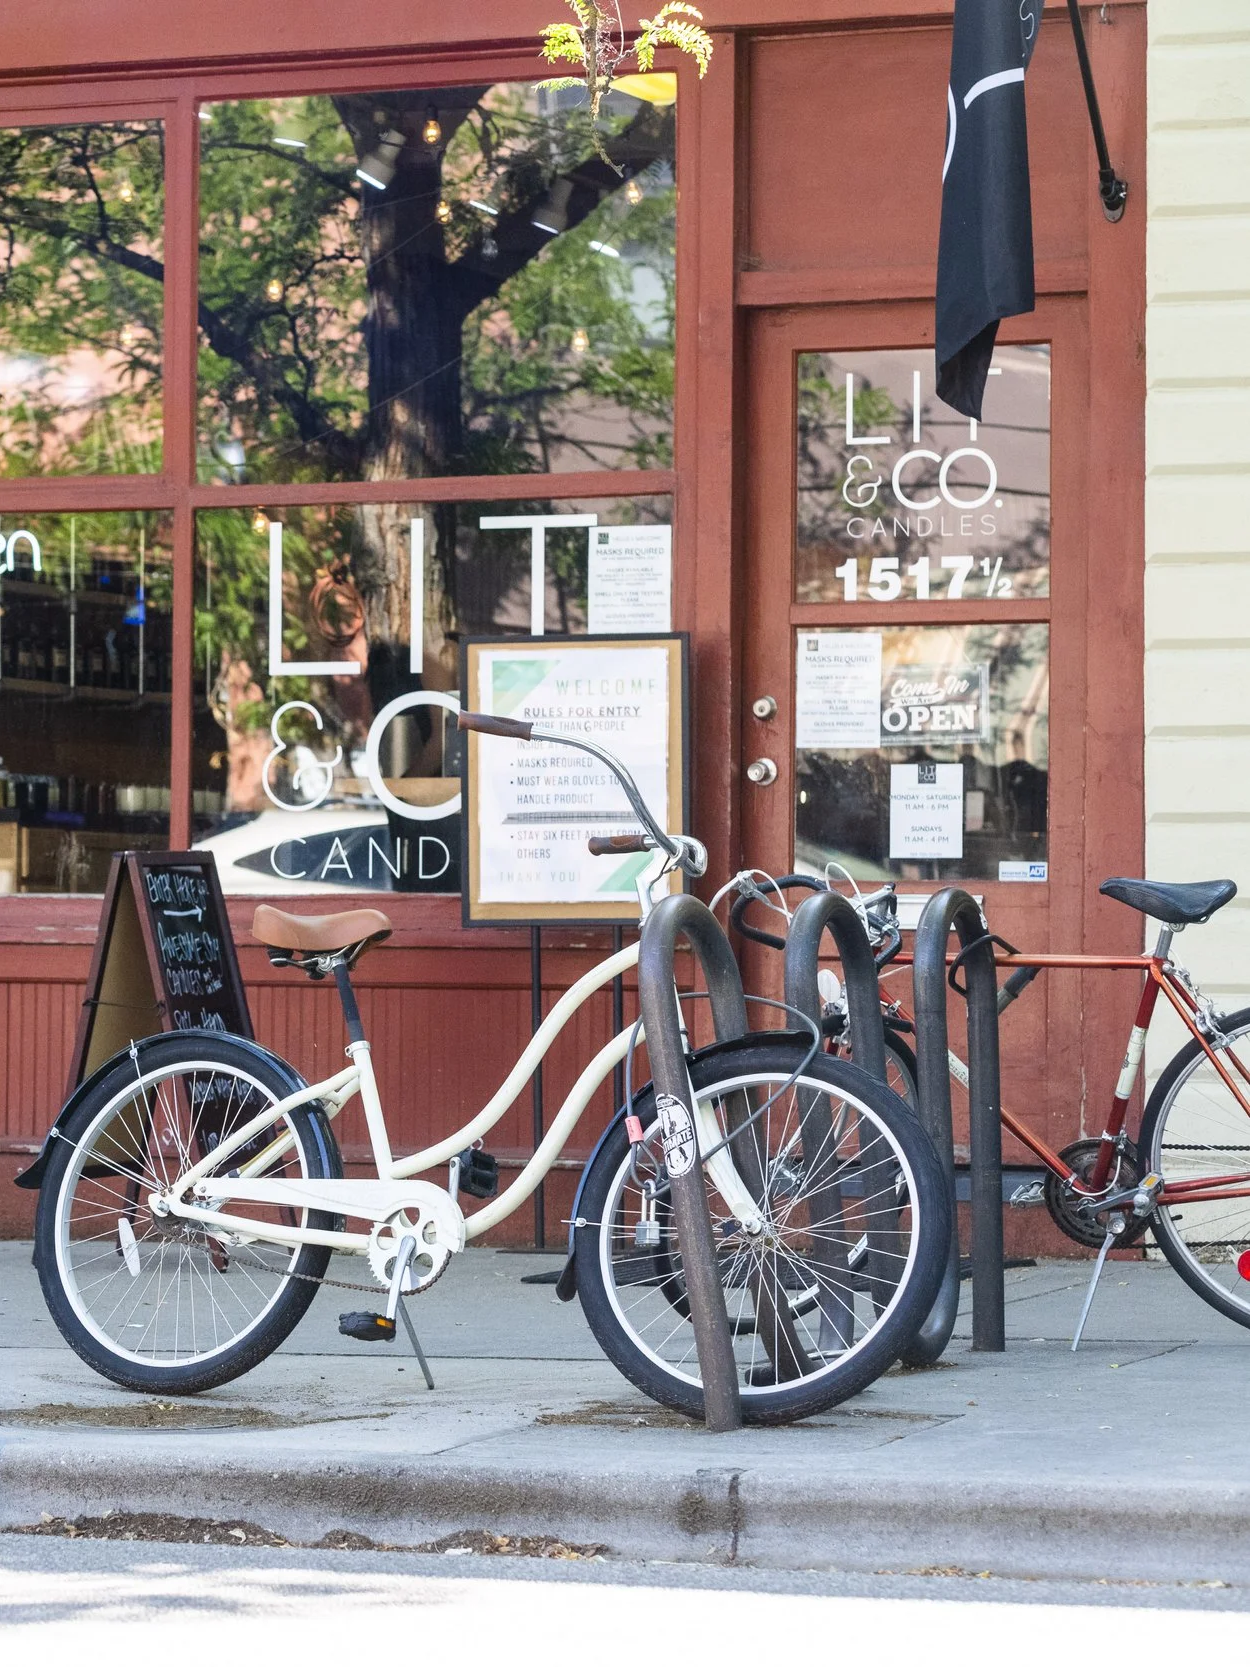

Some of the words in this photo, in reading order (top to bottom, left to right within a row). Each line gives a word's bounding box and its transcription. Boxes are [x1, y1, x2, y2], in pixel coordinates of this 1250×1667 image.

[847, 514, 997, 539] CANDLES
[596, 548, 623, 556] MASKS
[625, 547, 665, 556] REQUIRED
[835, 555, 974, 602] 1517
[269, 513, 598, 675] LIT
[834, 655, 875, 664] REQUIRED
[556, 678, 657, 697] WELCOME
[891, 678, 939, 698] Come
[943, 675, 970, 695] In
[524, 706, 567, 718] RULES
[569, 706, 596, 717] FOR
[599, 706, 641, 717] ENTRY
[881, 704, 978, 733] OPEN
[559, 720, 582, 732] THAN
[593, 720, 626, 732] PEOPLE
[517, 758, 548, 768] MASKS
[550, 757, 593, 768] REQUIRED
[517, 776, 540, 787] MUST
[544, 775, 569, 786] WEAR
[572, 775, 606, 786] GLOVES
[609, 775, 620, 786] TO
[517, 793, 551, 805] HANDLE
[554, 793, 593, 804] PRODUCT
[517, 830, 539, 841] STAY
[543, 830, 557, 841] SIX
[560, 830, 581, 841] FEET
[270, 836, 450, 879] CAND
[517, 848, 551, 859] OTHERS
[500, 871, 542, 883] THANK
[550, 871, 582, 883] YOU!
[1030, 866, 1045, 877] ADT
